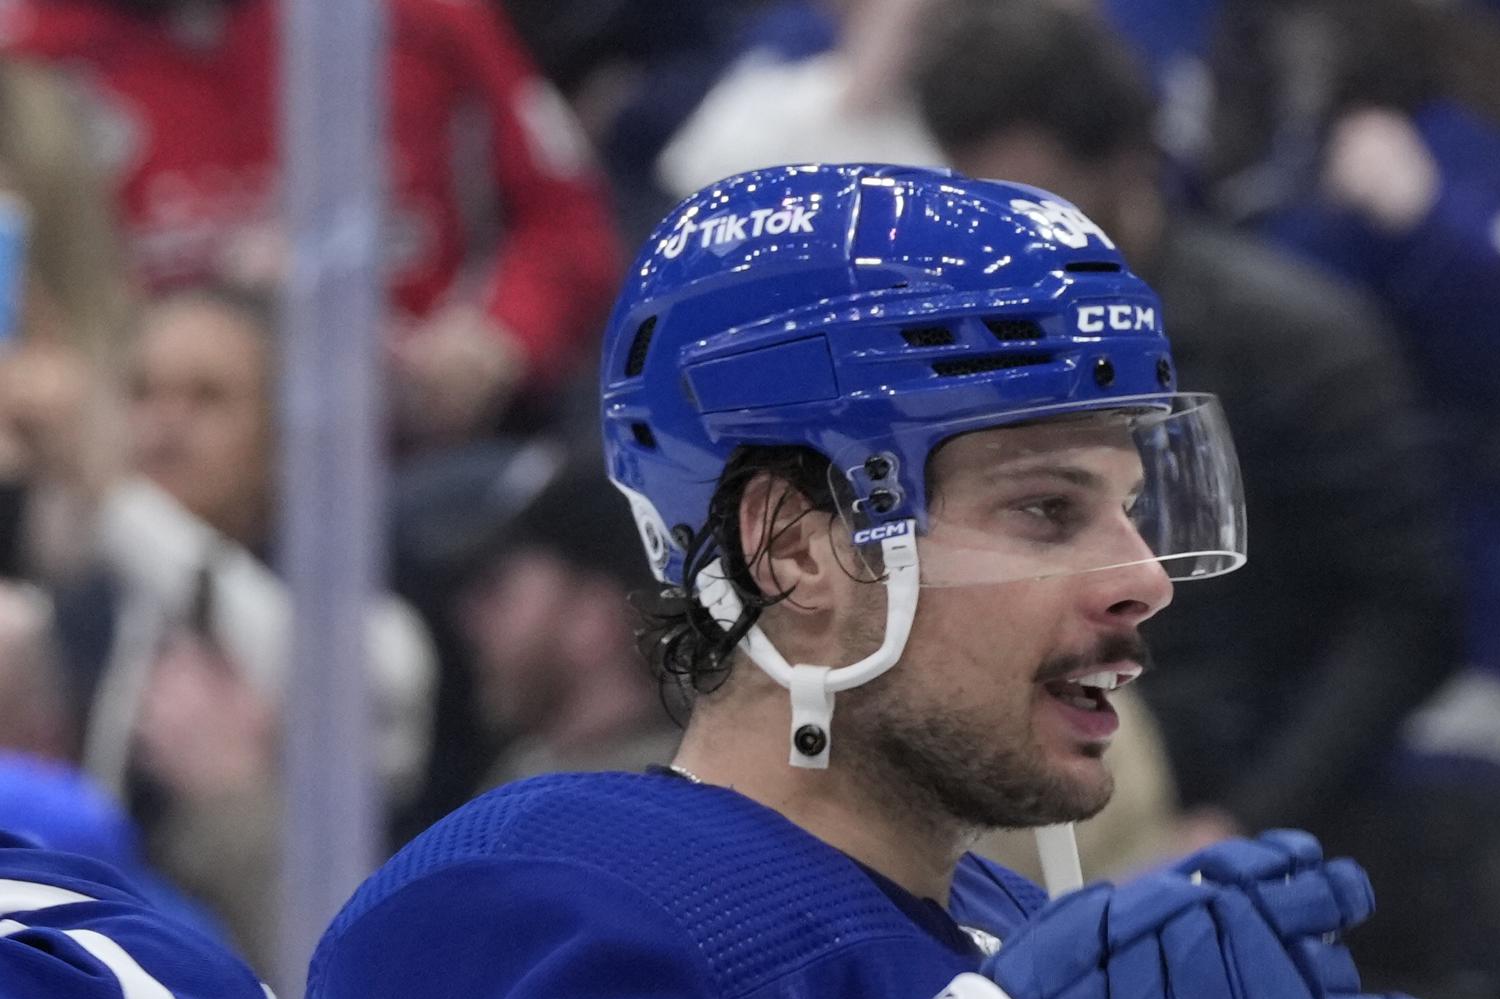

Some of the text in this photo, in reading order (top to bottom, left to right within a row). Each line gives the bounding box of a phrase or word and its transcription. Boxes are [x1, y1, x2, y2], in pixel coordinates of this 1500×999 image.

[699, 206, 818, 249] TikTok
[1076, 304, 1155, 333] CCM
[854, 521, 906, 545] CCM
